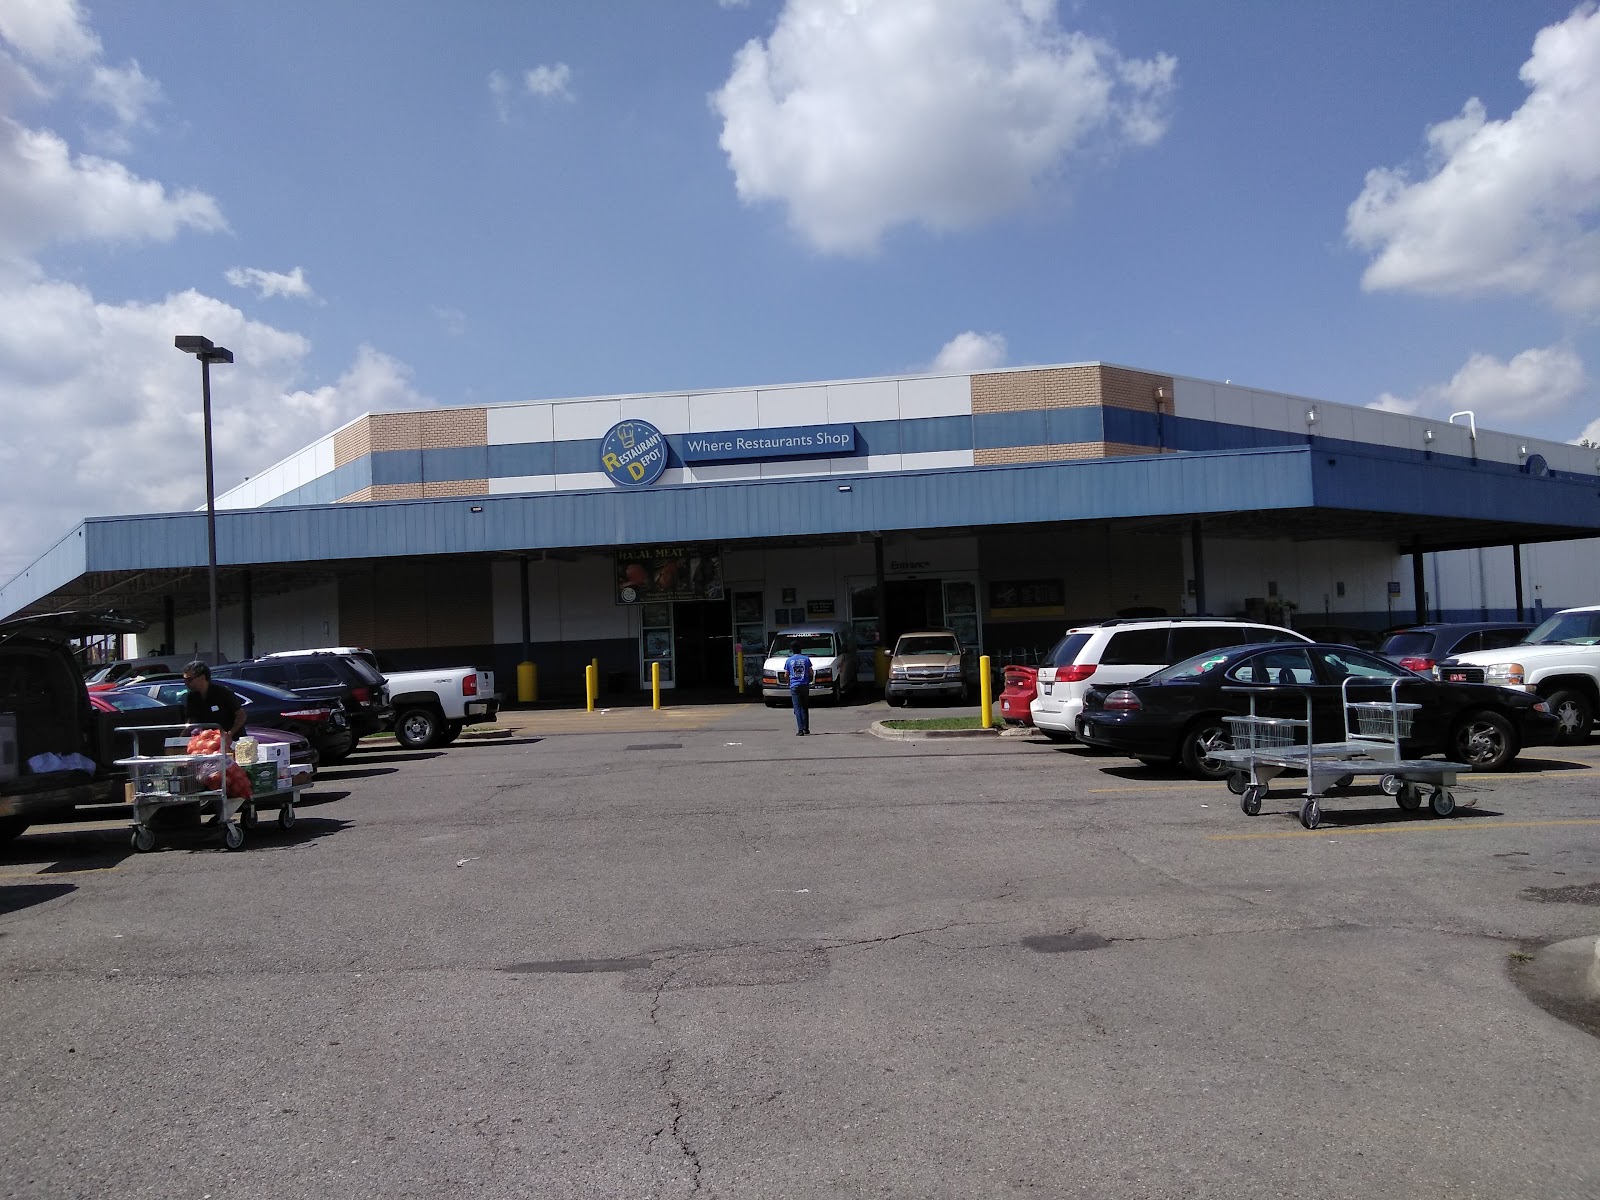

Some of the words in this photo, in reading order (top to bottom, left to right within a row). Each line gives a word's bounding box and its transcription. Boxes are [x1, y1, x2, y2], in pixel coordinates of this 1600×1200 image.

[602, 432, 662, 473] RESTAURANT
[687, 440, 733, 453] Where
[736, 435, 813, 450] Restaurants
[816, 432, 850, 447] Shop
[627, 448, 661, 481] DEPOT
[655, 548, 685, 558] MEAT
